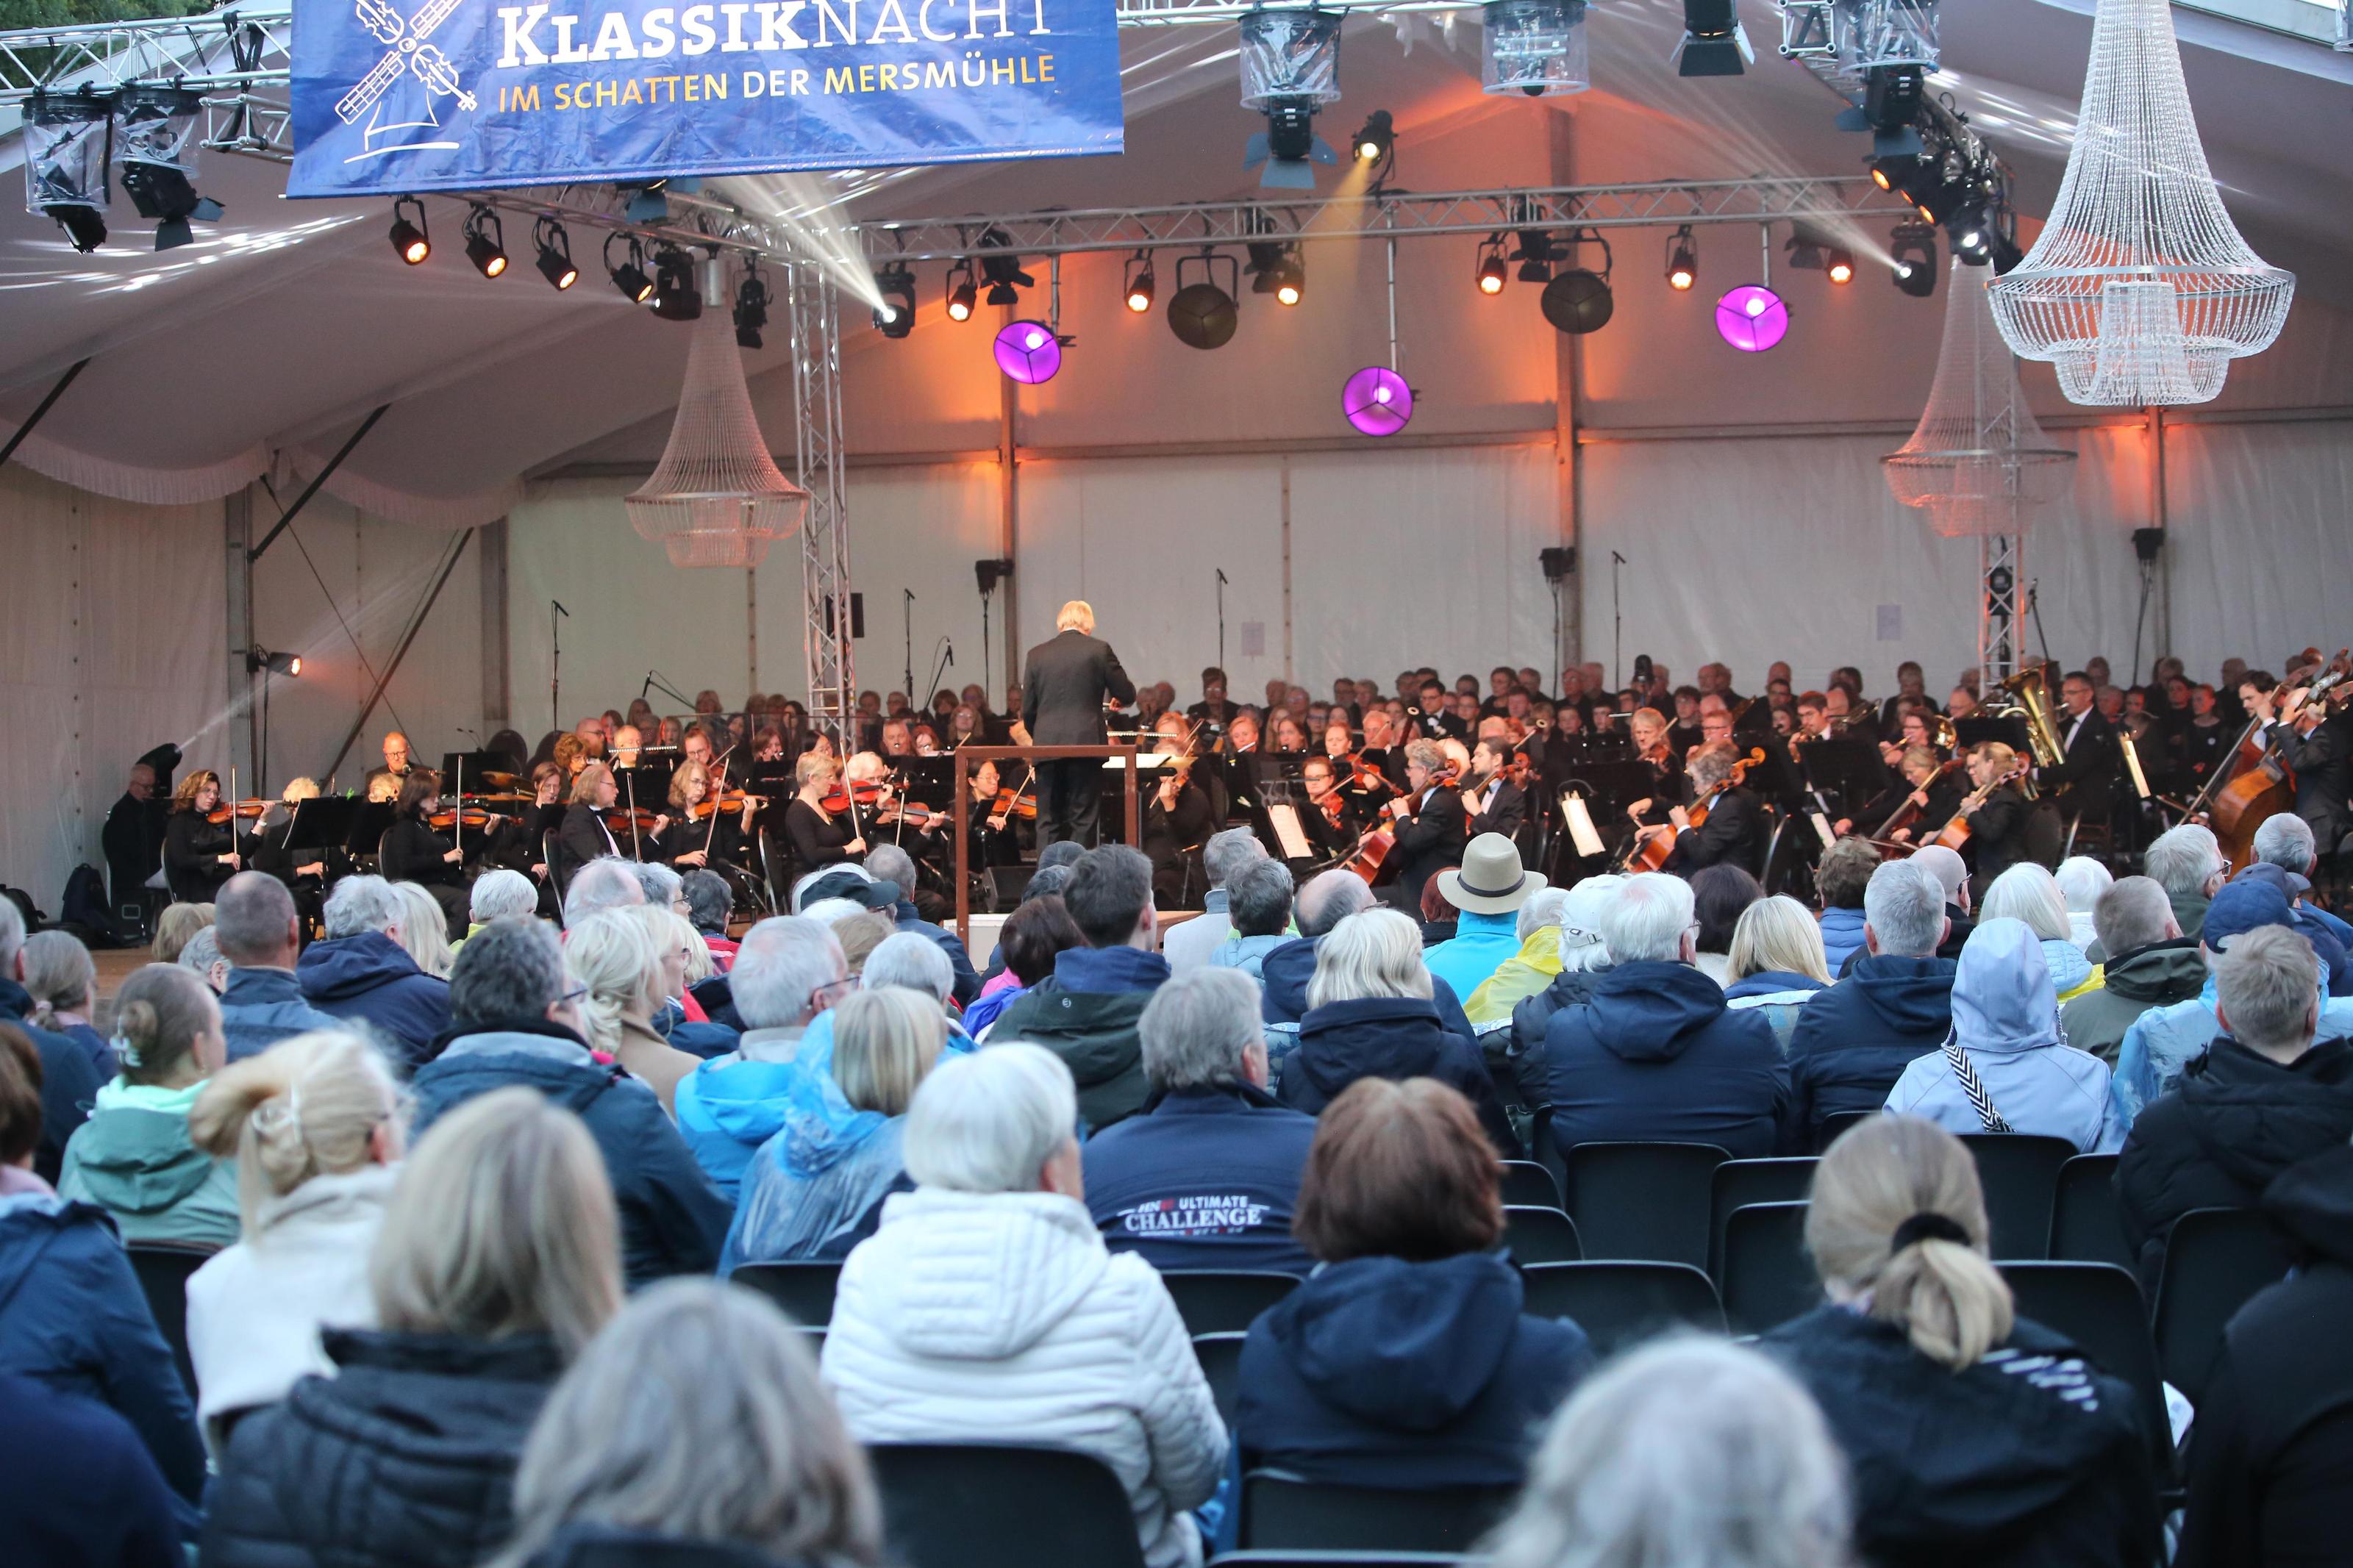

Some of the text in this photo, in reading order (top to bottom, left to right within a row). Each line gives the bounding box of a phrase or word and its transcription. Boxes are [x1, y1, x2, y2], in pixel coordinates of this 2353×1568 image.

[499, 51, 1054, 112] IM SCHATTEN DER MERSMÜHLE
[1179, 1196, 1249, 1210] ULTIMATE
[1124, 1209, 1262, 1231] CHALLENGE
